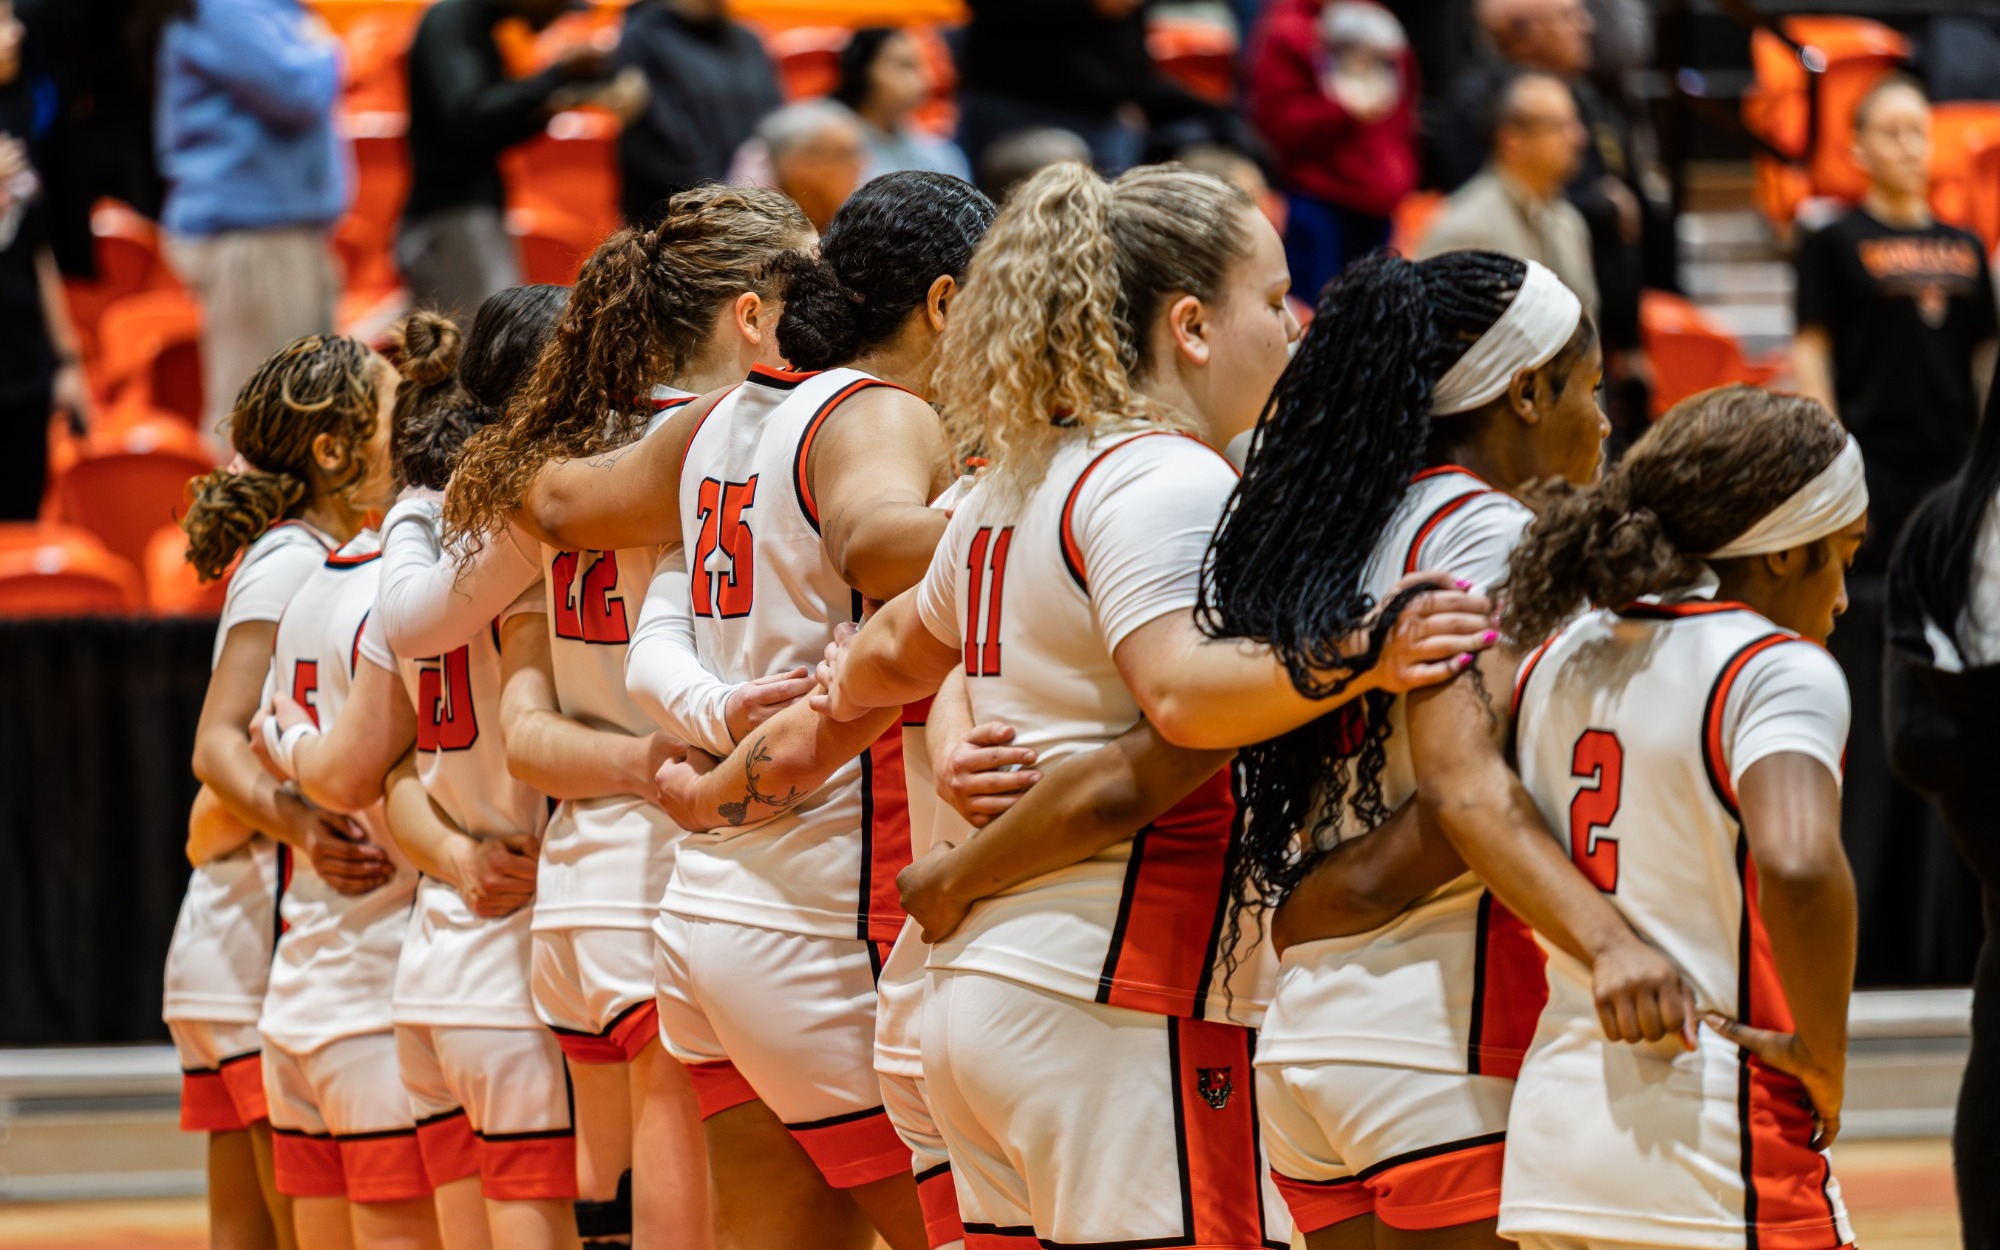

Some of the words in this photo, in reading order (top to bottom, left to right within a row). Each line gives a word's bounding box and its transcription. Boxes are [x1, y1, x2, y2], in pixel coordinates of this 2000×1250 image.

[552, 549, 630, 645] 22
[691, 473, 759, 620] 25
[965, 526, 1015, 677] 11
[1570, 727, 1624, 894] 2
